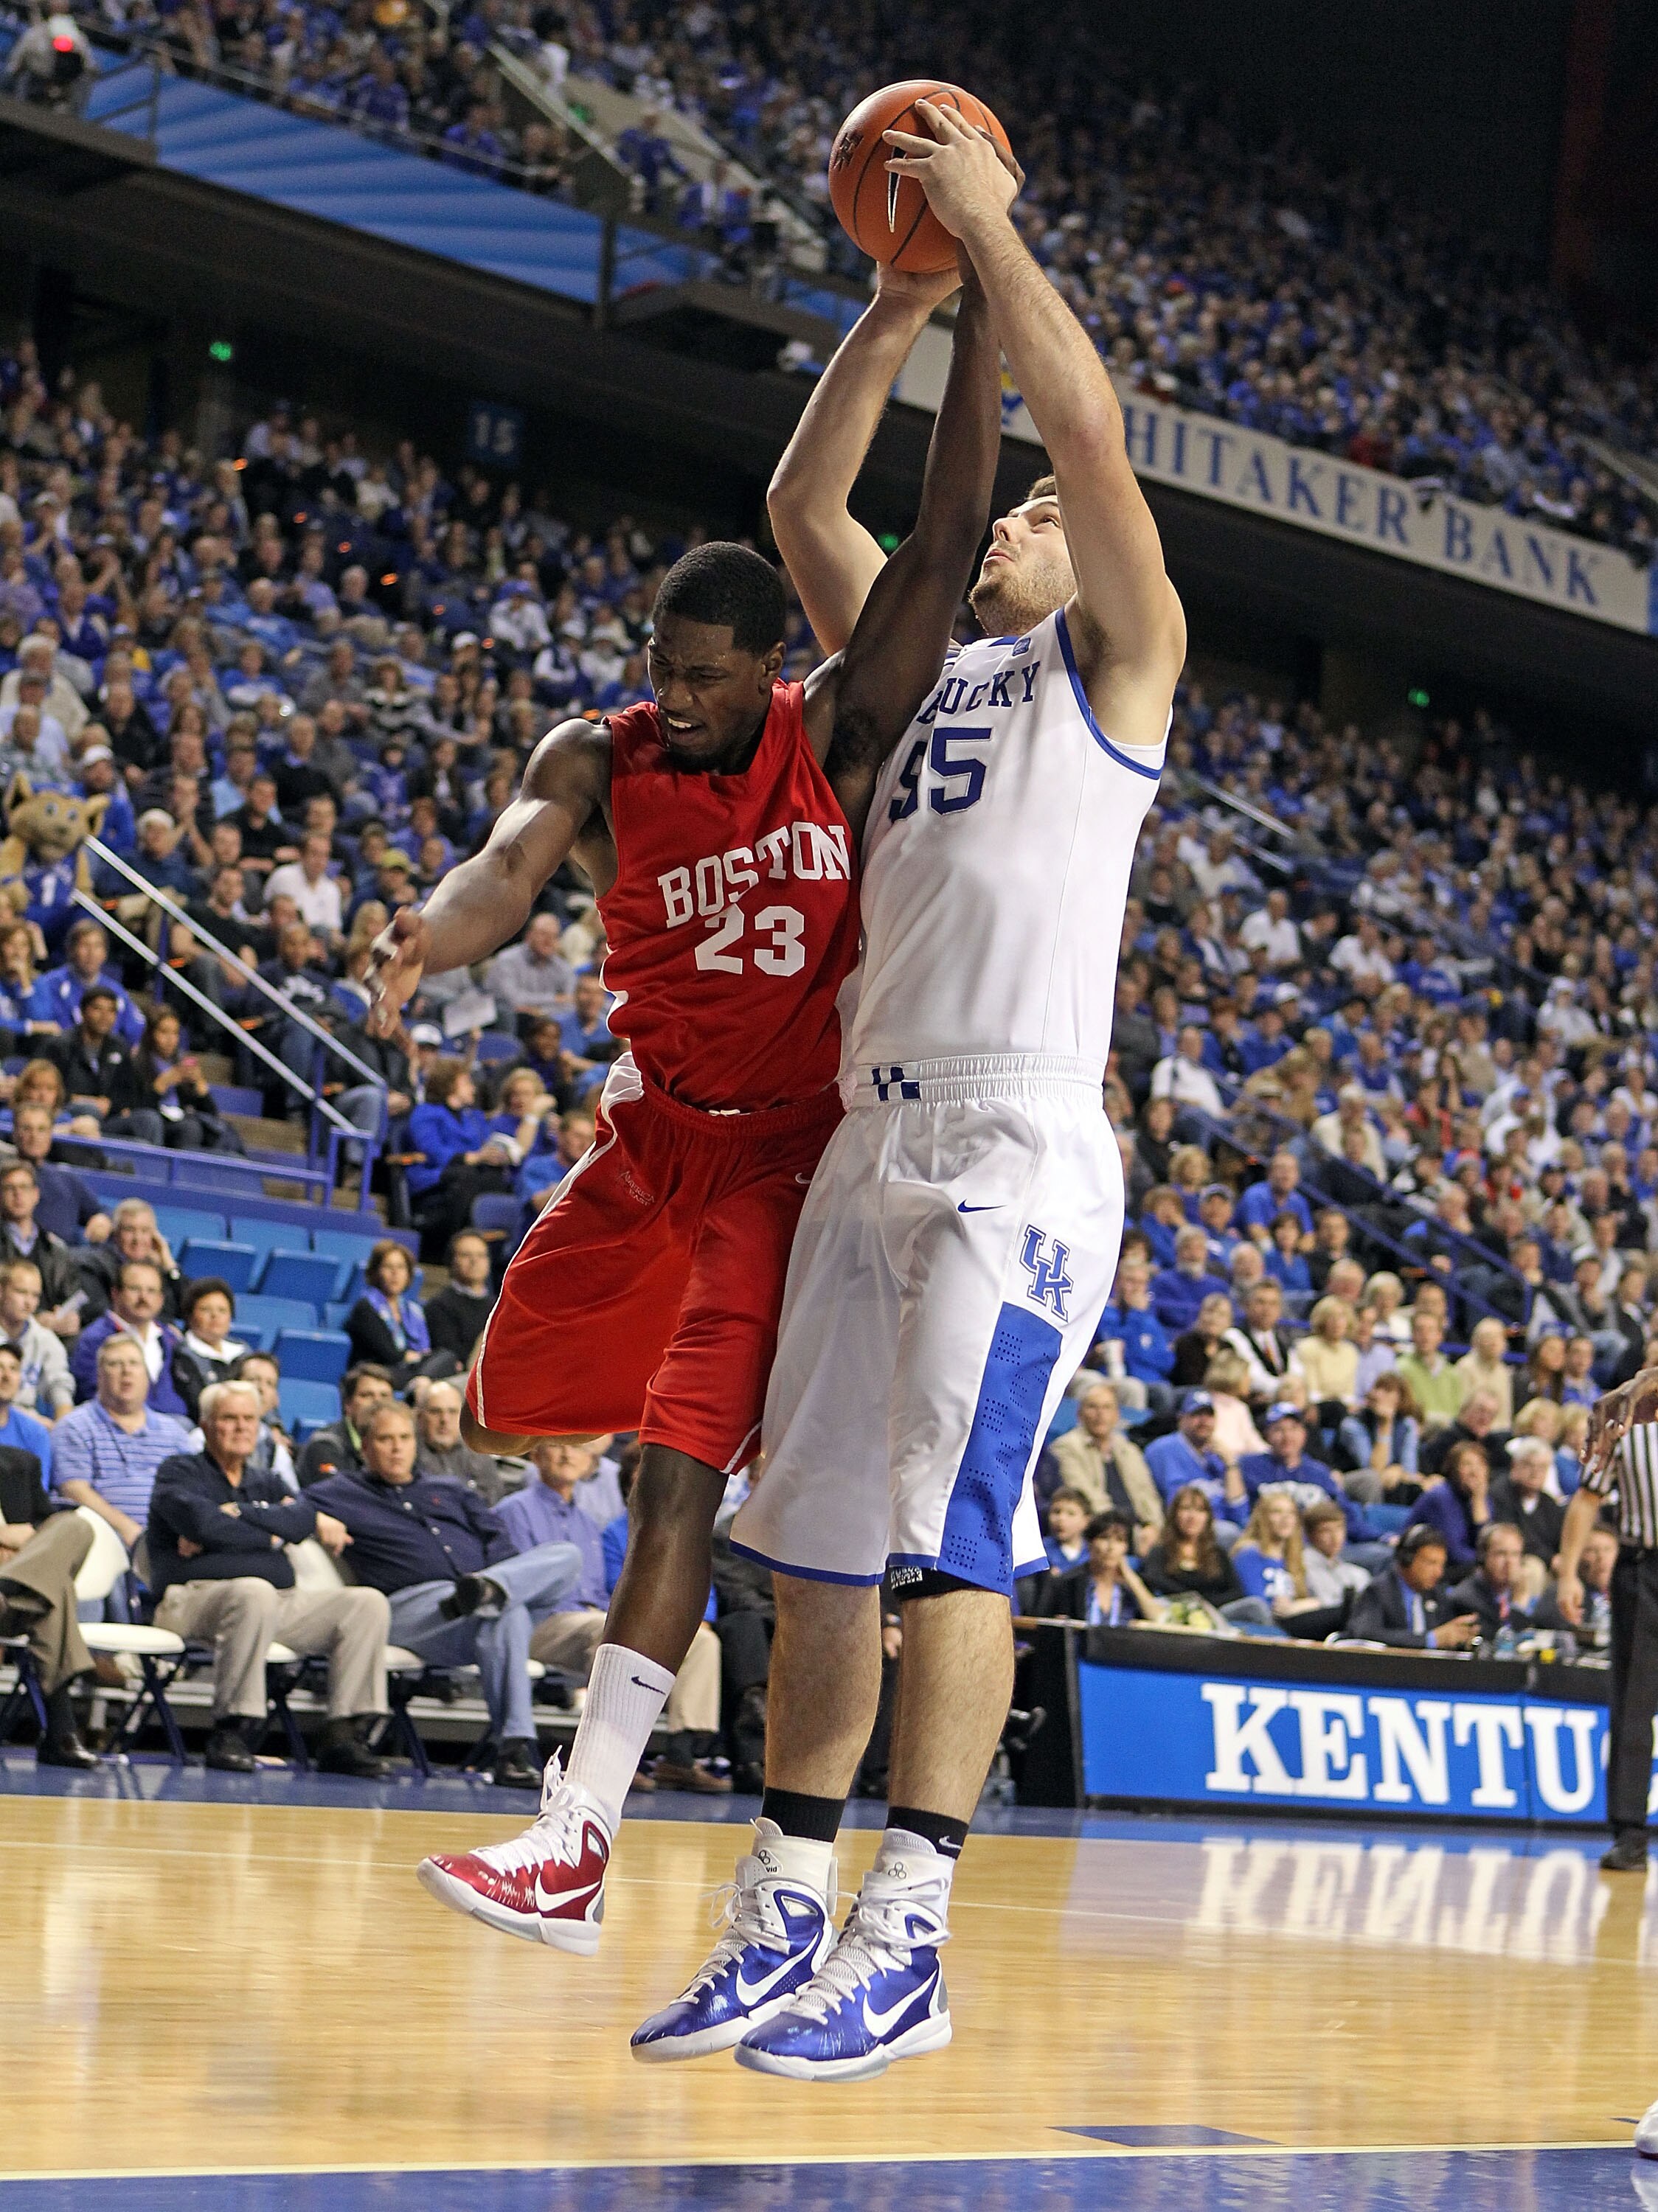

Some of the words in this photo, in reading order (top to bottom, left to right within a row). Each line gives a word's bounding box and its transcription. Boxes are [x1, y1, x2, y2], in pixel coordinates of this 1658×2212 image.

[1124, 404, 1408, 545] HITAKER
[1443, 501, 1599, 605] BANK
[658, 821, 851, 929] BOSTON
[694, 902, 805, 977] 23
[1019, 1224, 1074, 1323] UK
[1201, 1682, 1658, 1815] KENTU
